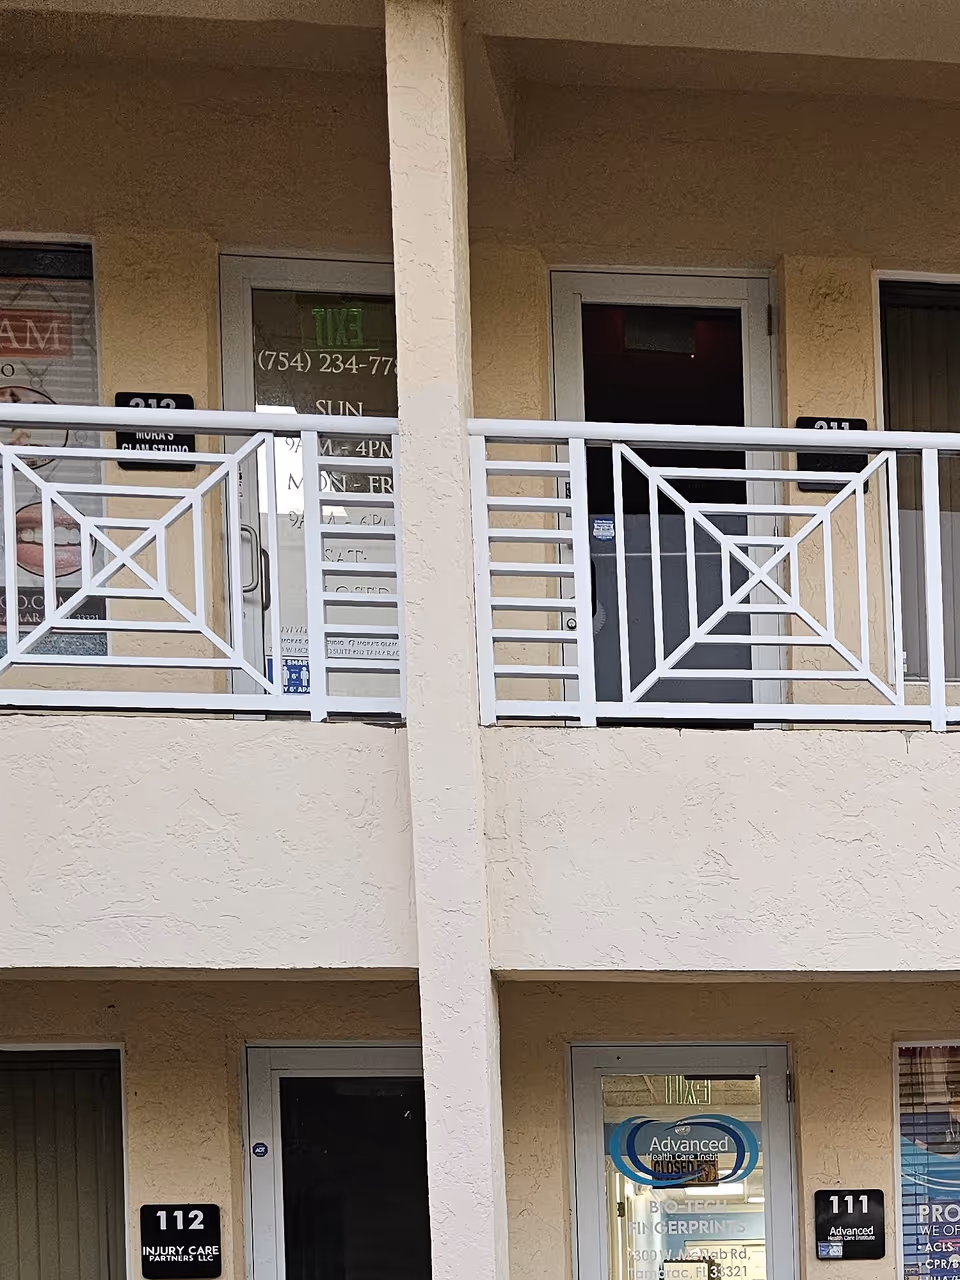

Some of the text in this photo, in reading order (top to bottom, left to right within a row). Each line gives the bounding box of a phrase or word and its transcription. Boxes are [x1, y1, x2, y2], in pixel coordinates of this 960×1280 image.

[258, 349, 311, 373] (754)
[649, 1136, 729, 1152] Advanced
[646, 1152, 694, 1161] Health Care
[653, 1160, 694, 1174] CLOSED
[829, 1194, 868, 1214] 111
[156, 1210, 204, 1230] 112
[628, 1220, 746, 1235] FINGERPRINTS
[829, 1226, 874, 1236] Advanced
[920, 1226, 939, 1236] WE
[143, 1245, 220, 1256] INJURY CARE
[924, 1242, 954, 1252] ACLS
[149, 1254, 214, 1262] PARTNERS LLC
[730, 1248, 751, 1262] Rd,
[710, 1266, 747, 1278] 33321
